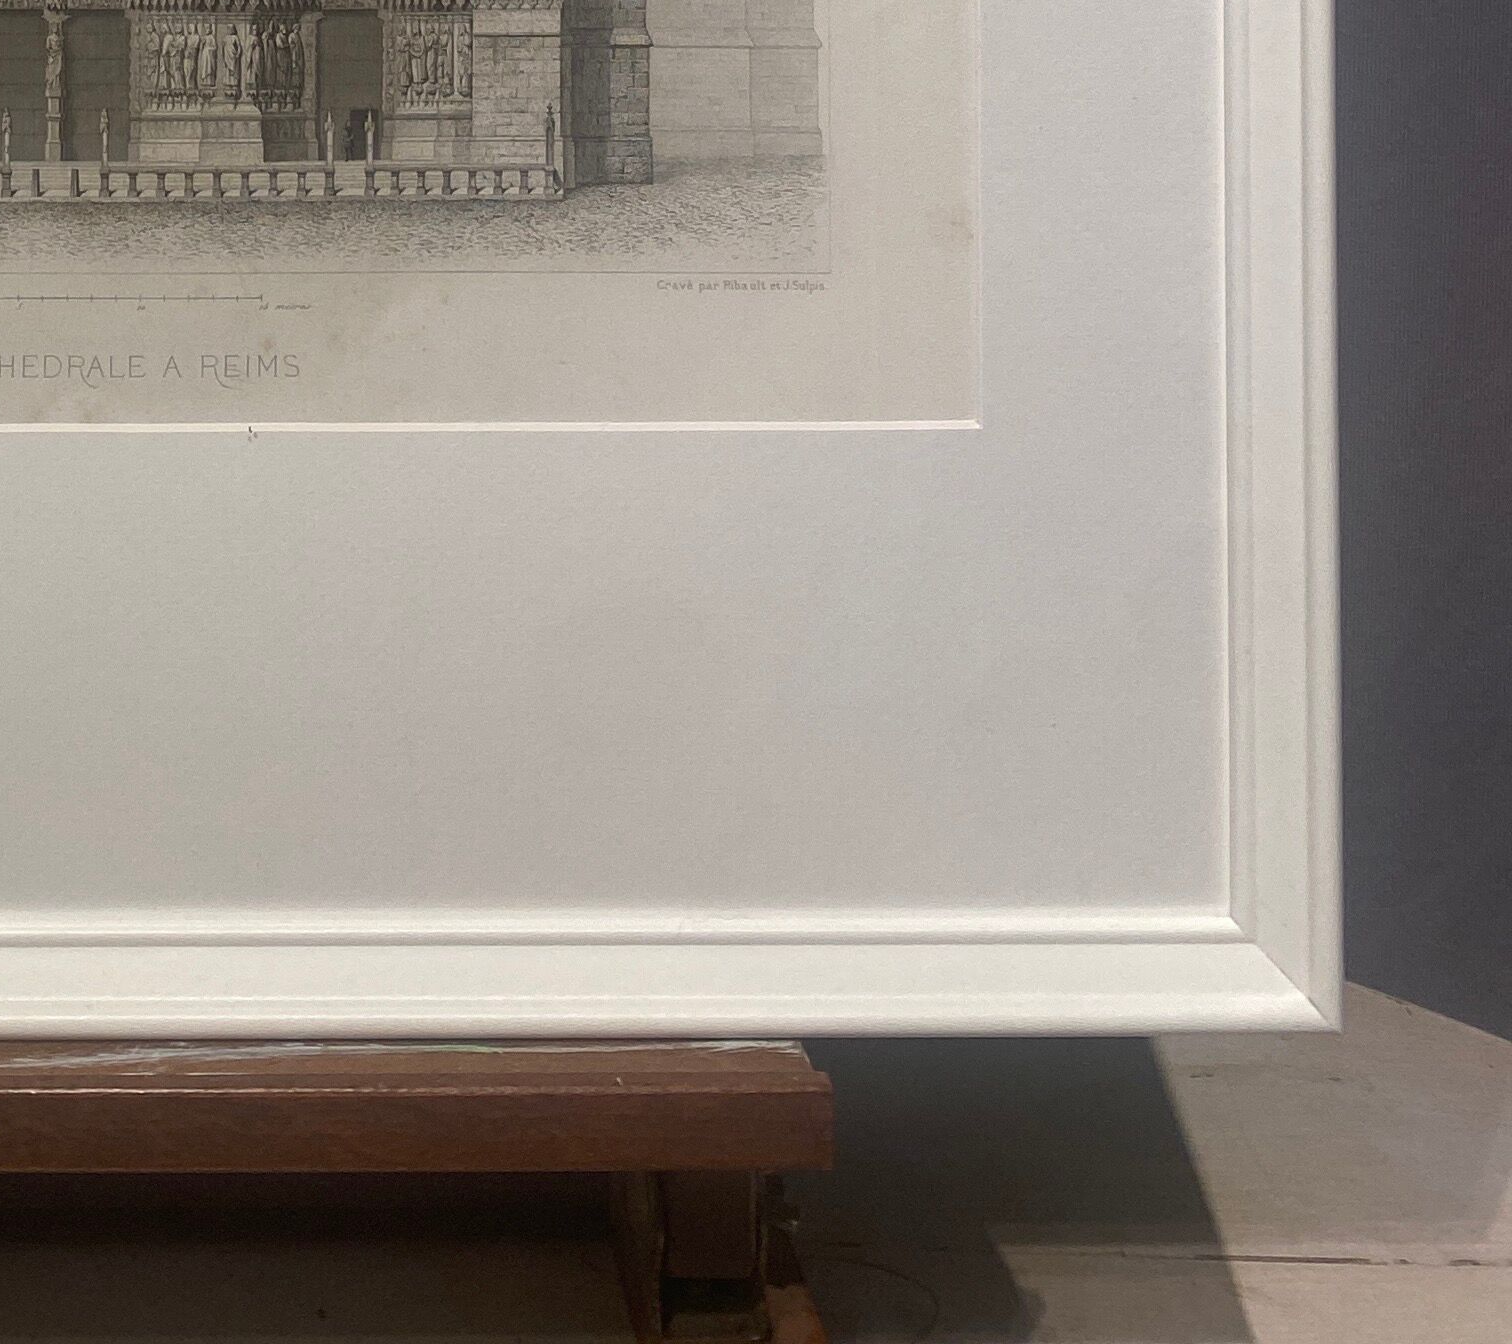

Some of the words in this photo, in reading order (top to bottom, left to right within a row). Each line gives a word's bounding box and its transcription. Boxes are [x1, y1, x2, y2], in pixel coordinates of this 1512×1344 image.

[698, 281, 720, 294] par
[162, 353, 184, 380] A
[199, 353, 302, 390] REIMS
